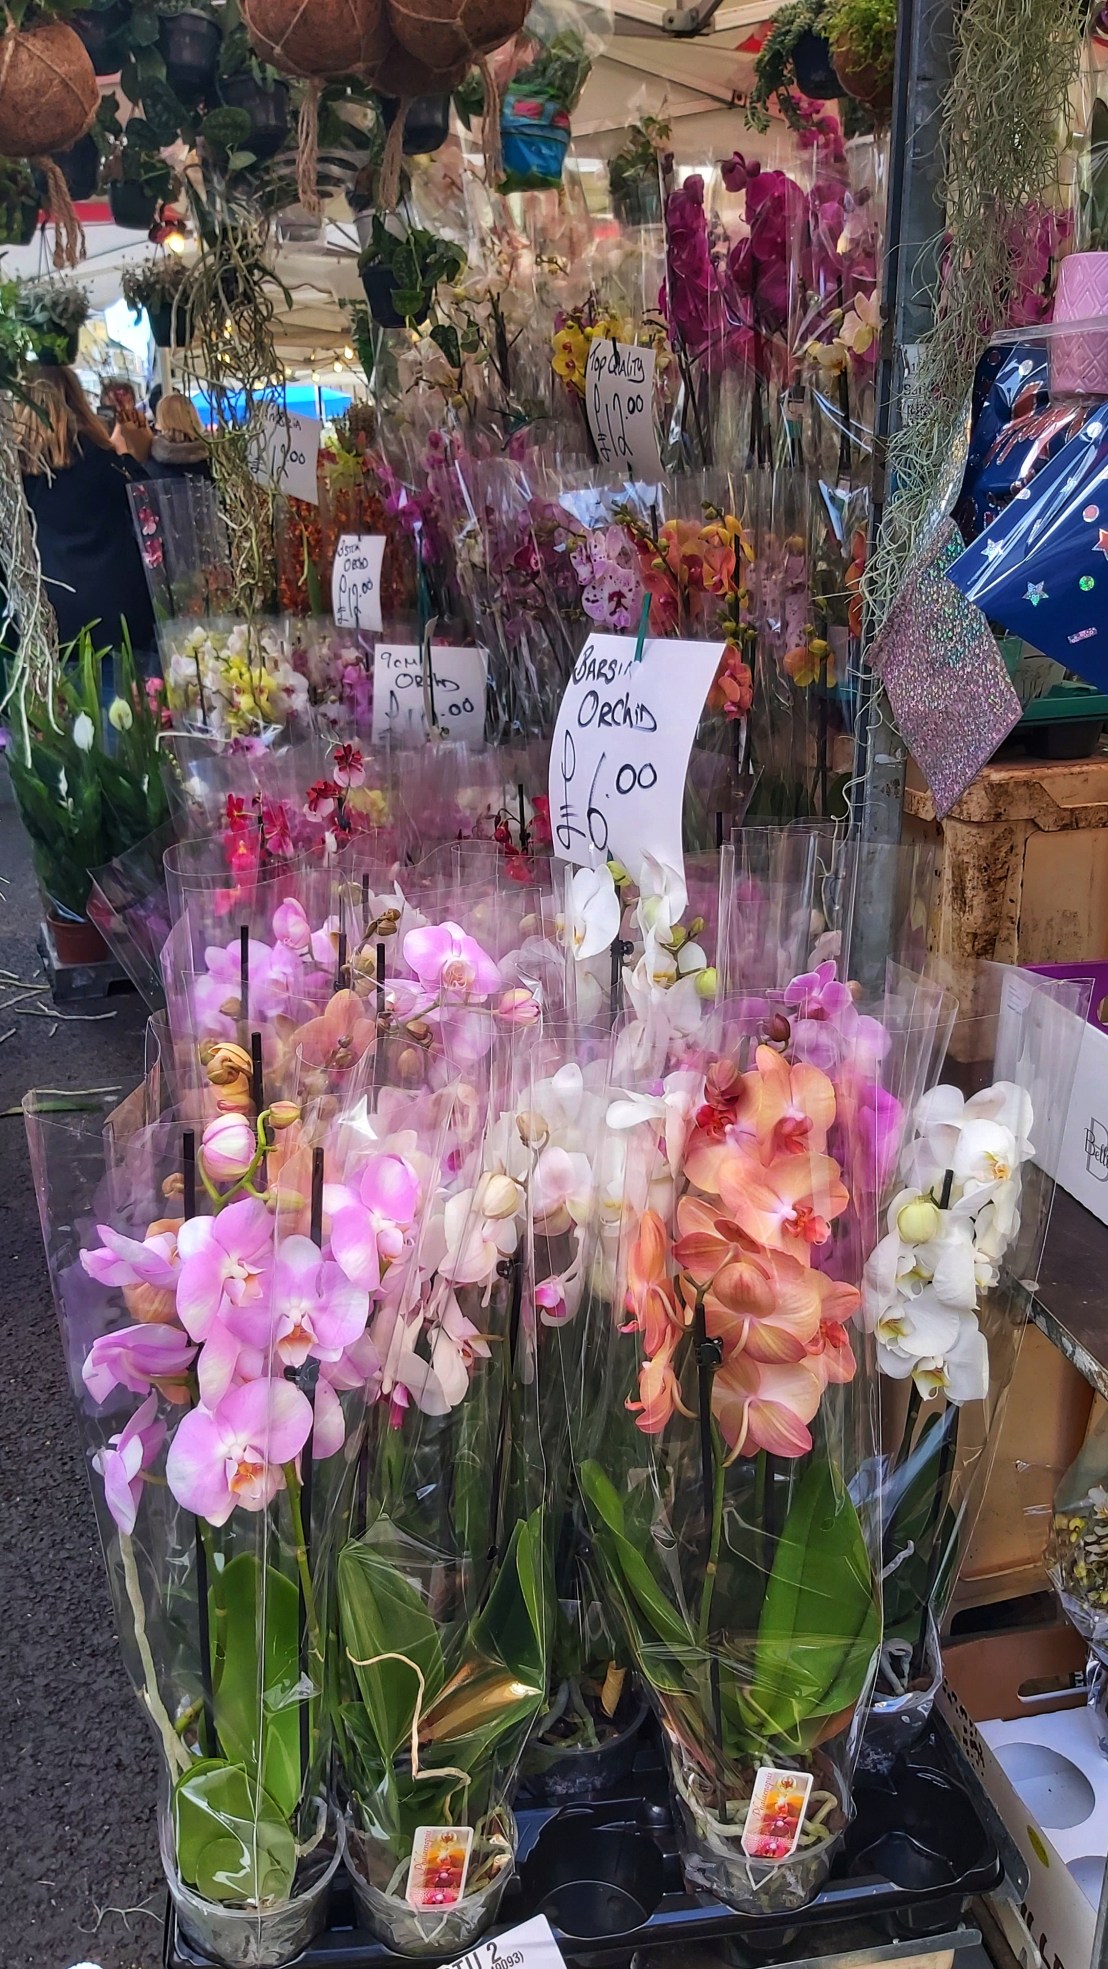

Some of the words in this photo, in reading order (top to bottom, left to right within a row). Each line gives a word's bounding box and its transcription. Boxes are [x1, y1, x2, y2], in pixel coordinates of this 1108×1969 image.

[593, 383, 644, 462] £12.00
[337, 574, 373, 624] £12.00
[556, 729, 657, 850] £6.00
[486, 1941, 502, 1964] 2
